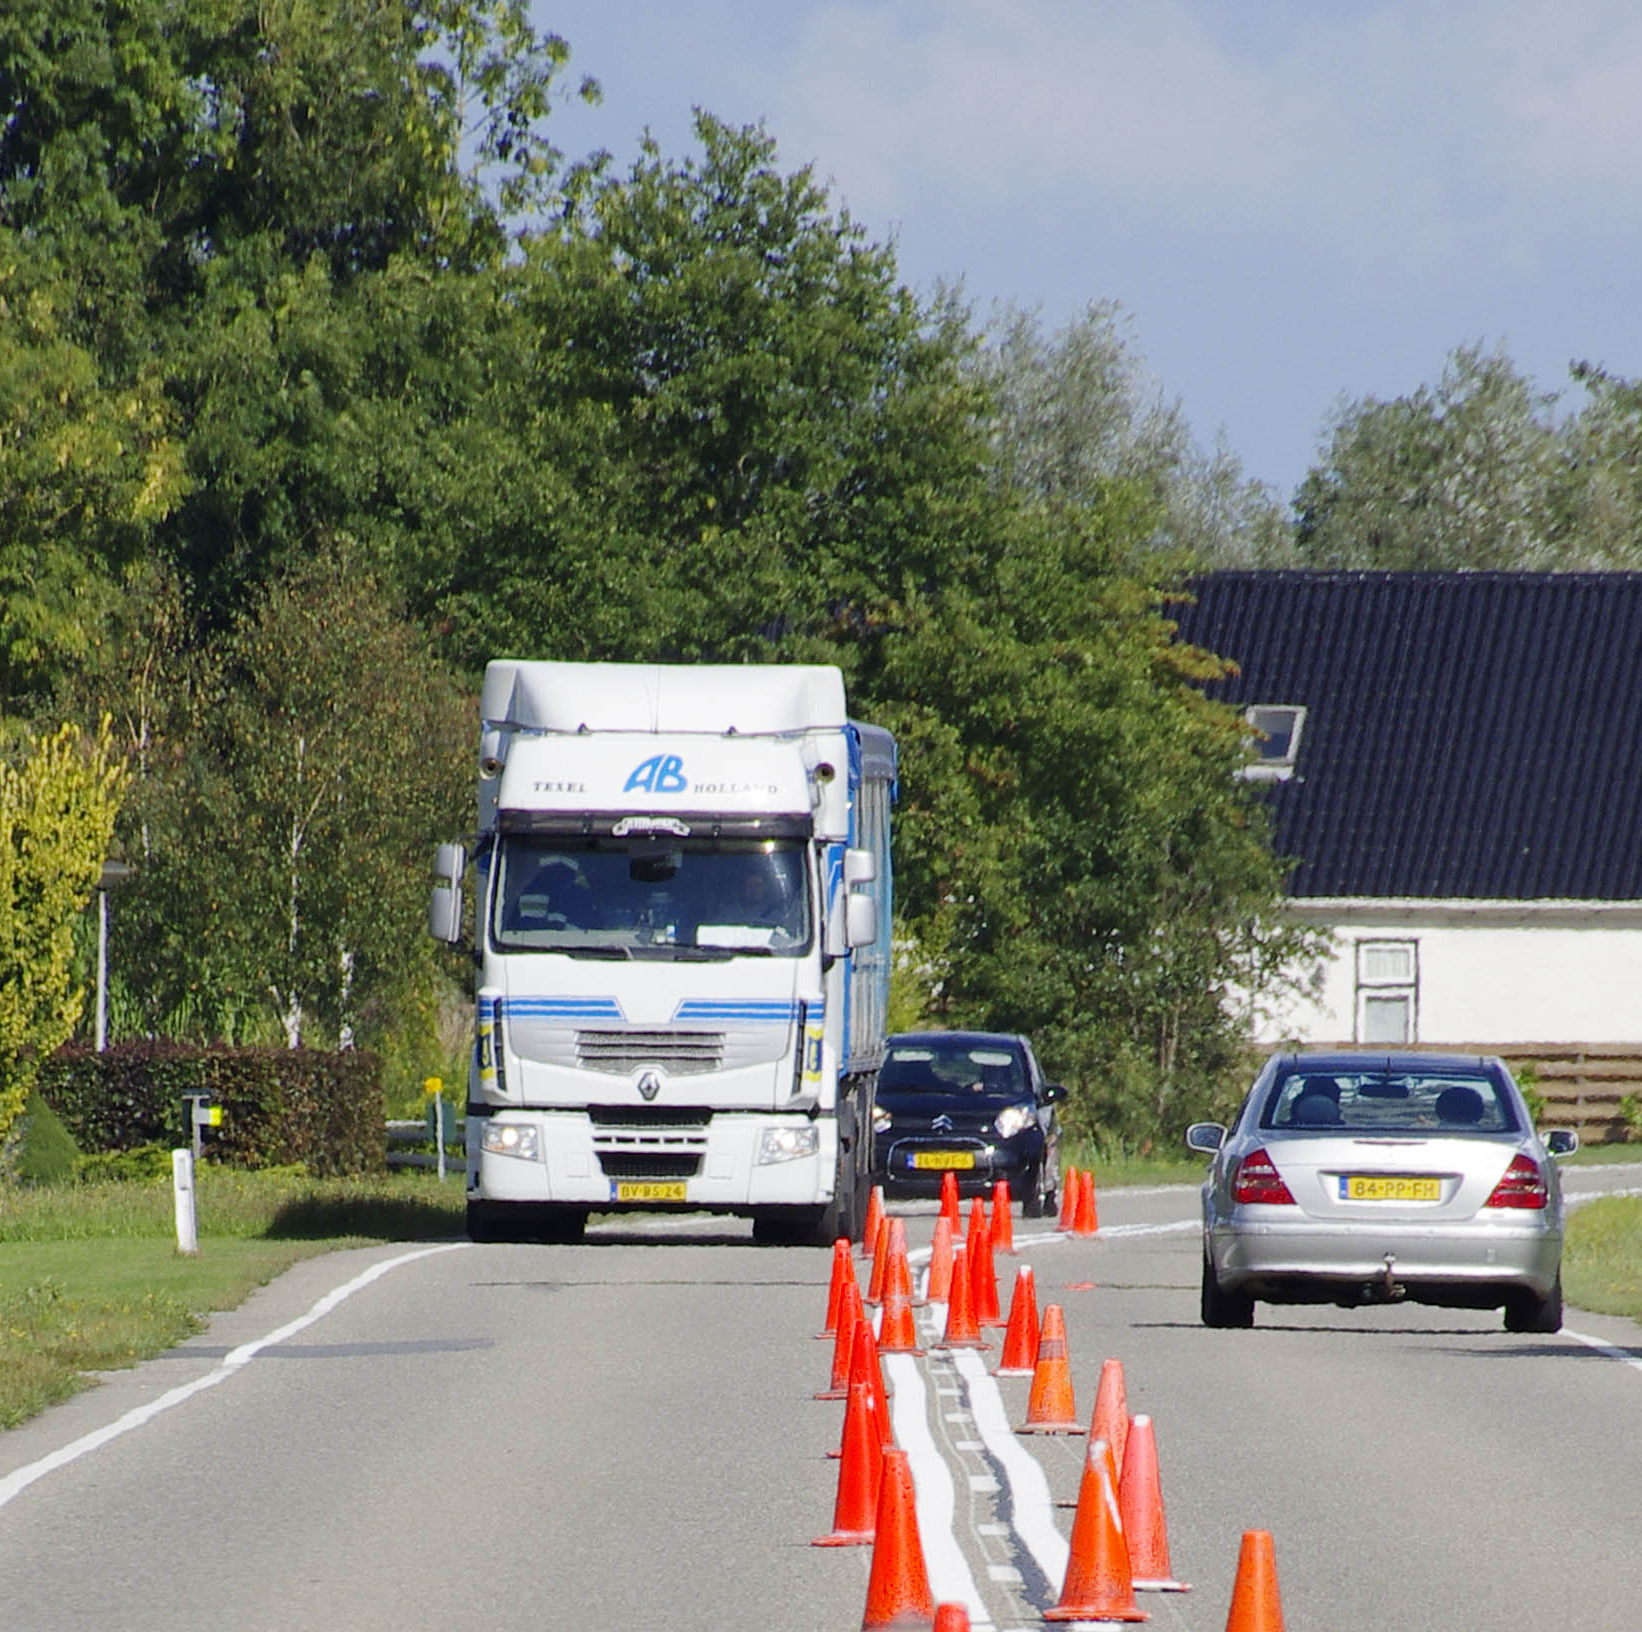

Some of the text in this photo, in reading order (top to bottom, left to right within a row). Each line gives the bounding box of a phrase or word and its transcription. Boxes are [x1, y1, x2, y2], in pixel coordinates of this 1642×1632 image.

[533, 781, 587, 793] TEXEL
[623, 754, 688, 793] AB
[1355, 1181, 1435, 1197] 84-PP-FH
